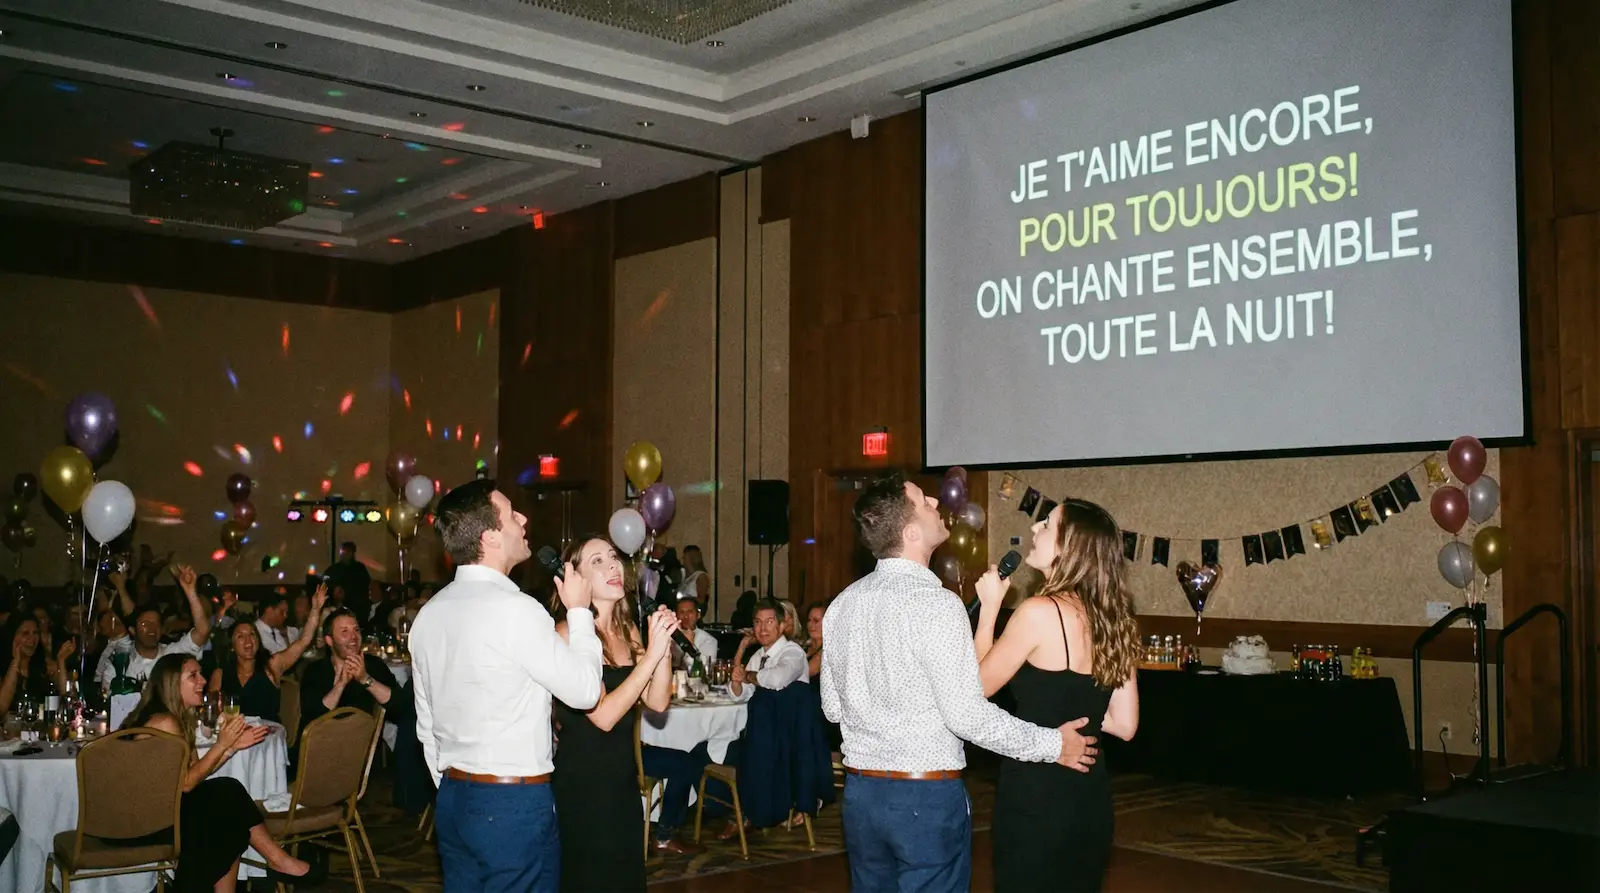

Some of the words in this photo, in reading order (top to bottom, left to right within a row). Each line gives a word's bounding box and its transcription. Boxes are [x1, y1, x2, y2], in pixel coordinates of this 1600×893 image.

[1010, 159, 1049, 204] JE
[1056, 134, 1174, 193] T'AIME
[1185, 85, 1373, 166] ENCORE,
[1019, 202, 1117, 257] POUR
[1125, 152, 1358, 237] TOUJOURS!
[976, 275, 1022, 319] ON
[1032, 249, 1175, 311] CHANTE
[1187, 209, 1433, 289] ENSEMBLE,
[1040, 312, 1158, 366] TOUTE
[1169, 306, 1217, 352] LA
[1226, 289, 1334, 346] NUIT!
